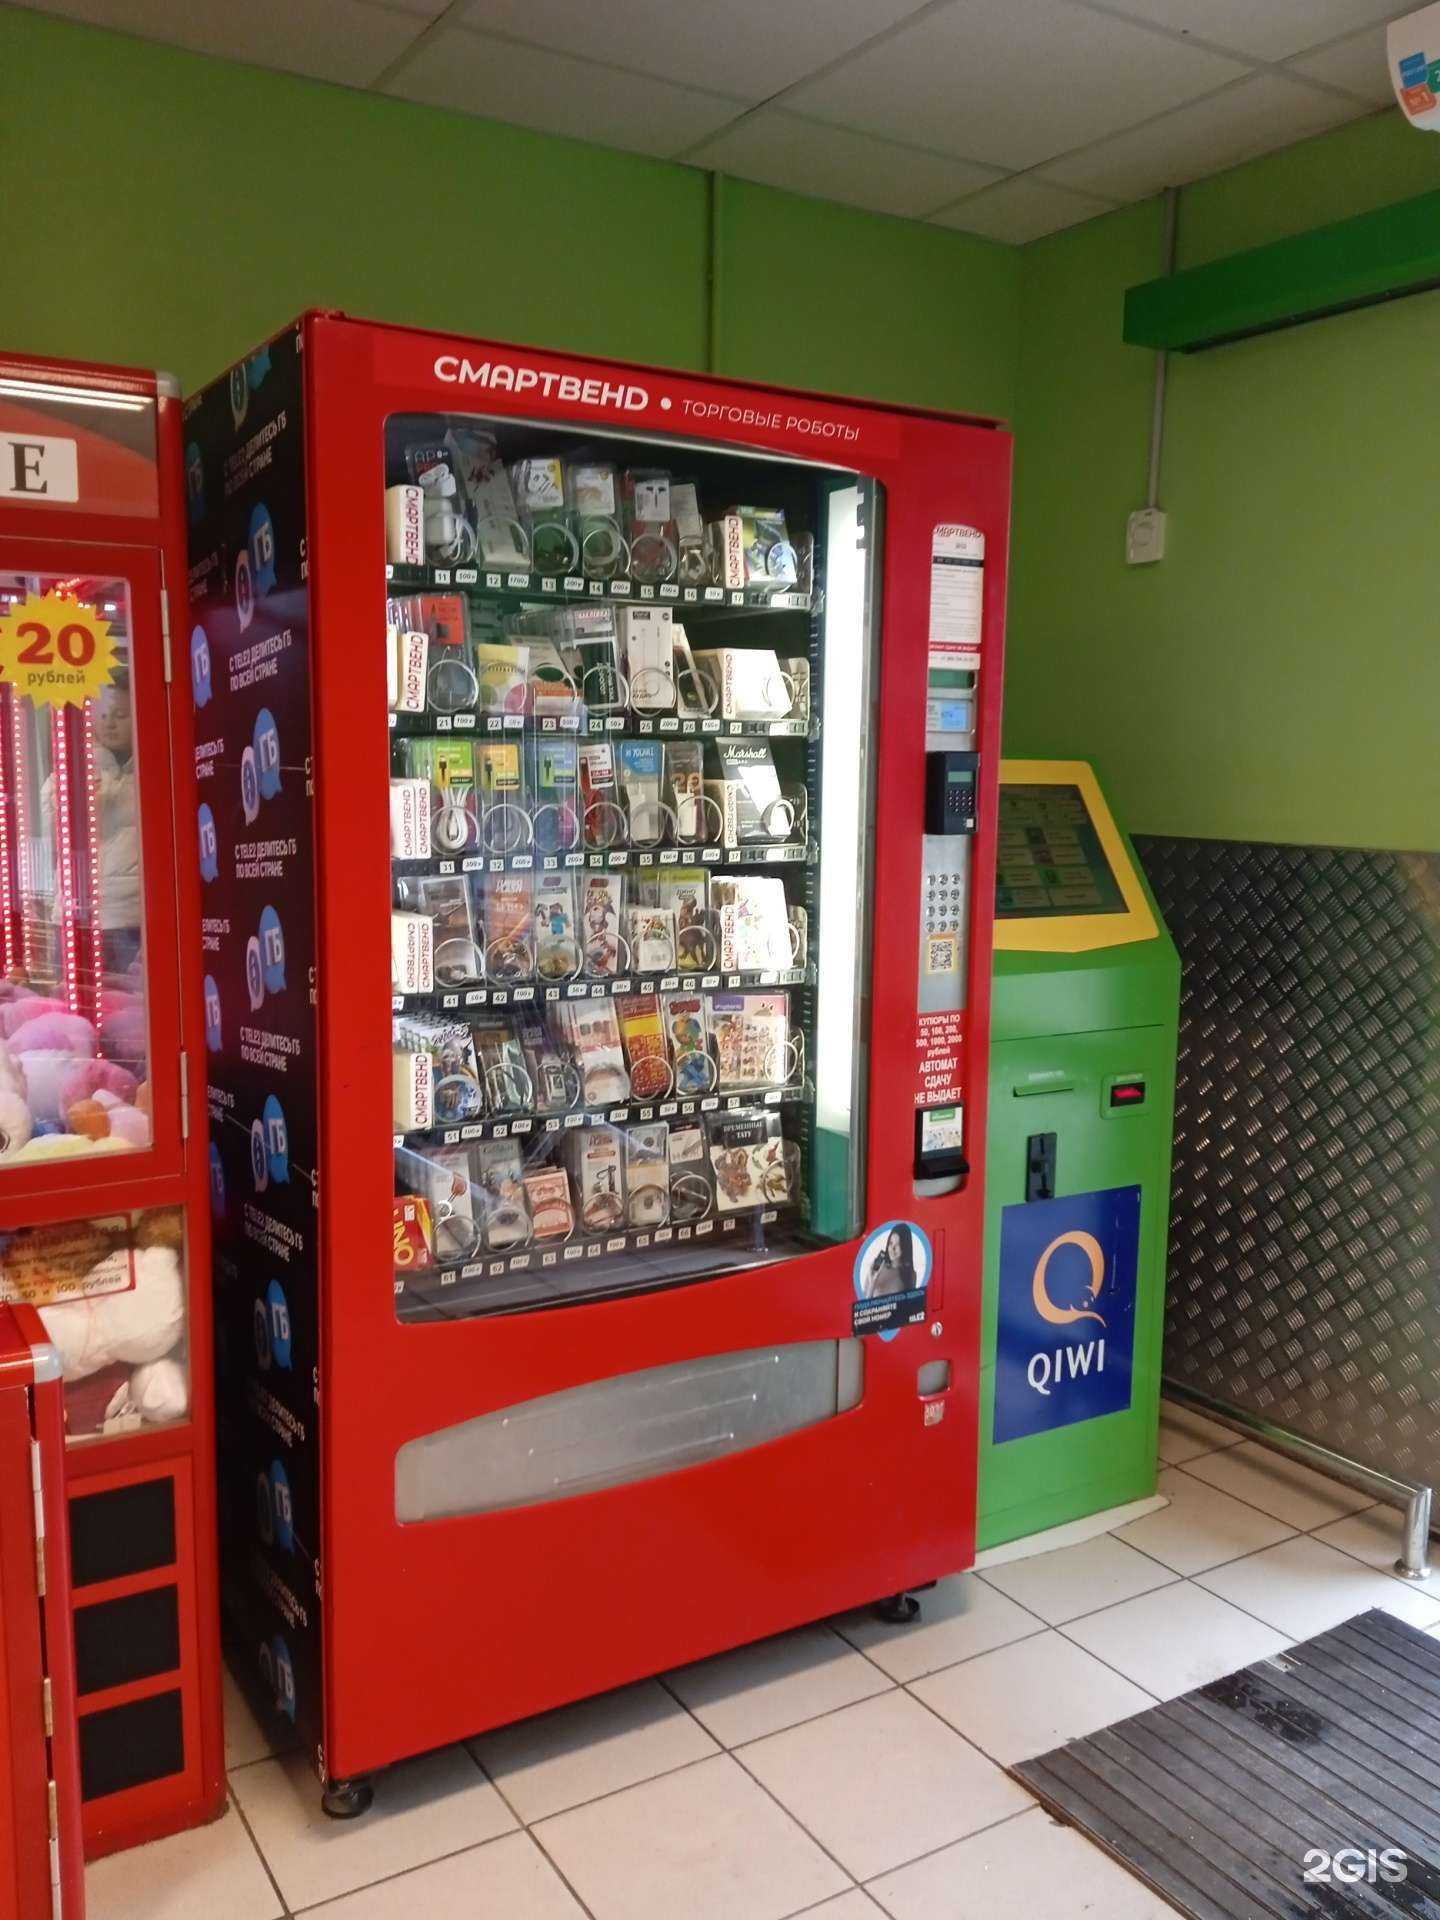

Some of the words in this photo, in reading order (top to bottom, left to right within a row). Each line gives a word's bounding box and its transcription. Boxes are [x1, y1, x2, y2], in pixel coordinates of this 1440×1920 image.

[682, 399, 782, 429] ТОРГОВЫЕ
[786, 416, 860, 441] РОБОТЫ
[16, 622, 96, 667] 20
[250, 634, 282, 668] ДЕЛИТЕСЬ
[282, 629, 292, 648] ГБ
[27, 669, 86, 687] рублей
[255, 657, 278, 682] СТРАНЕ
[723, 745, 767, 759] Marshall
[256, 840, 287, 862] ДЕЛИТЕСЬ
[288, 838, 297, 856] ГБ
[235, 863, 245, 879] ПО
[245, 861, 260, 878] ВСЕЙ
[260, 860, 283, 879] СТРАНЕ
[265, 927, 282, 966] ГБ
[950, 1014, 960, 1023] ПО
[261, 1031, 292, 1054] ДЕЛИТЕСЬ
[292, 1038, 301, 1056] ГБ
[241, 1045, 250, 1061] ПО
[265, 1051, 288, 1072] СТРАНЕ
[919, 1057, 958, 1074] АВТОМАТ
[925, 1073, 952, 1089] СДАЧУ
[914, 1092, 926, 1104] НЕ
[927, 1087, 962, 1104] ВЫДАЕТ
[268, 1118, 286, 1156] ГБ
[83, 1275, 122, 1292] рублей
[1027, 1339, 1105, 1395] QIWI
